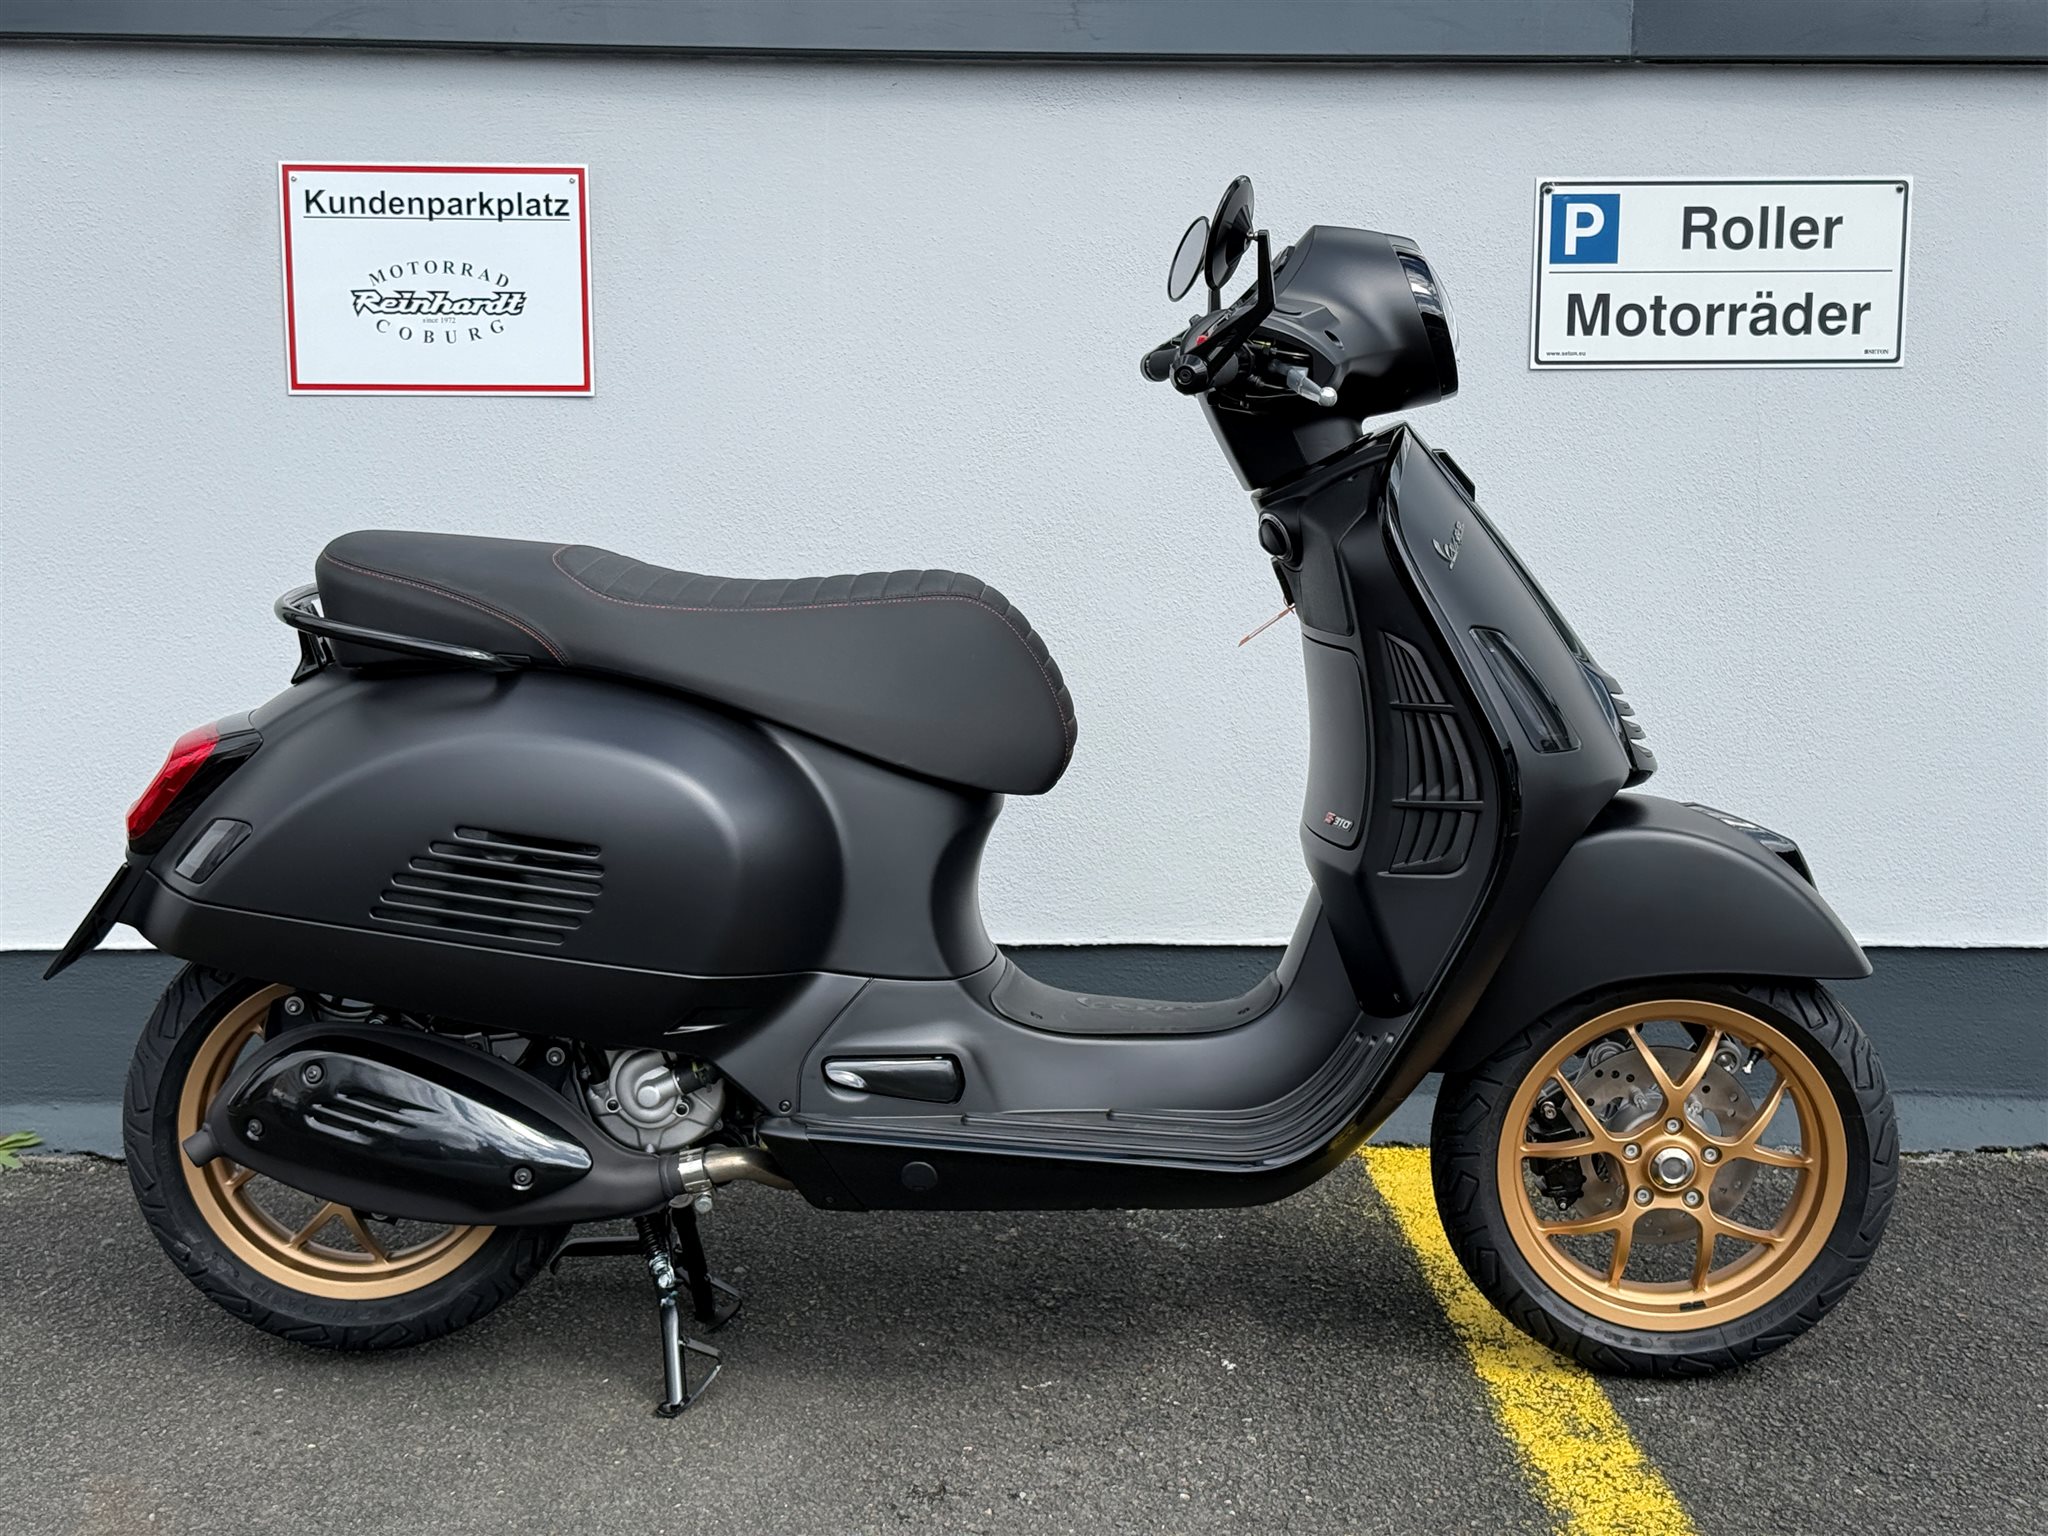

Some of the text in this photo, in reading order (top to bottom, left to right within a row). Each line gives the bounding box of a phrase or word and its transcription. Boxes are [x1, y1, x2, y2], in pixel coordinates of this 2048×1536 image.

[304, 188, 571, 222] Kundenparkplatz
[1563, 202, 1844, 256] P Roller
[368, 259, 511, 289] MOTORRAD
[350, 288, 528, 317] Reinhardt
[1565, 290, 1872, 337] Motorräder
[375, 318, 506, 345] COBURG
[440, 316, 457, 324] 1972
